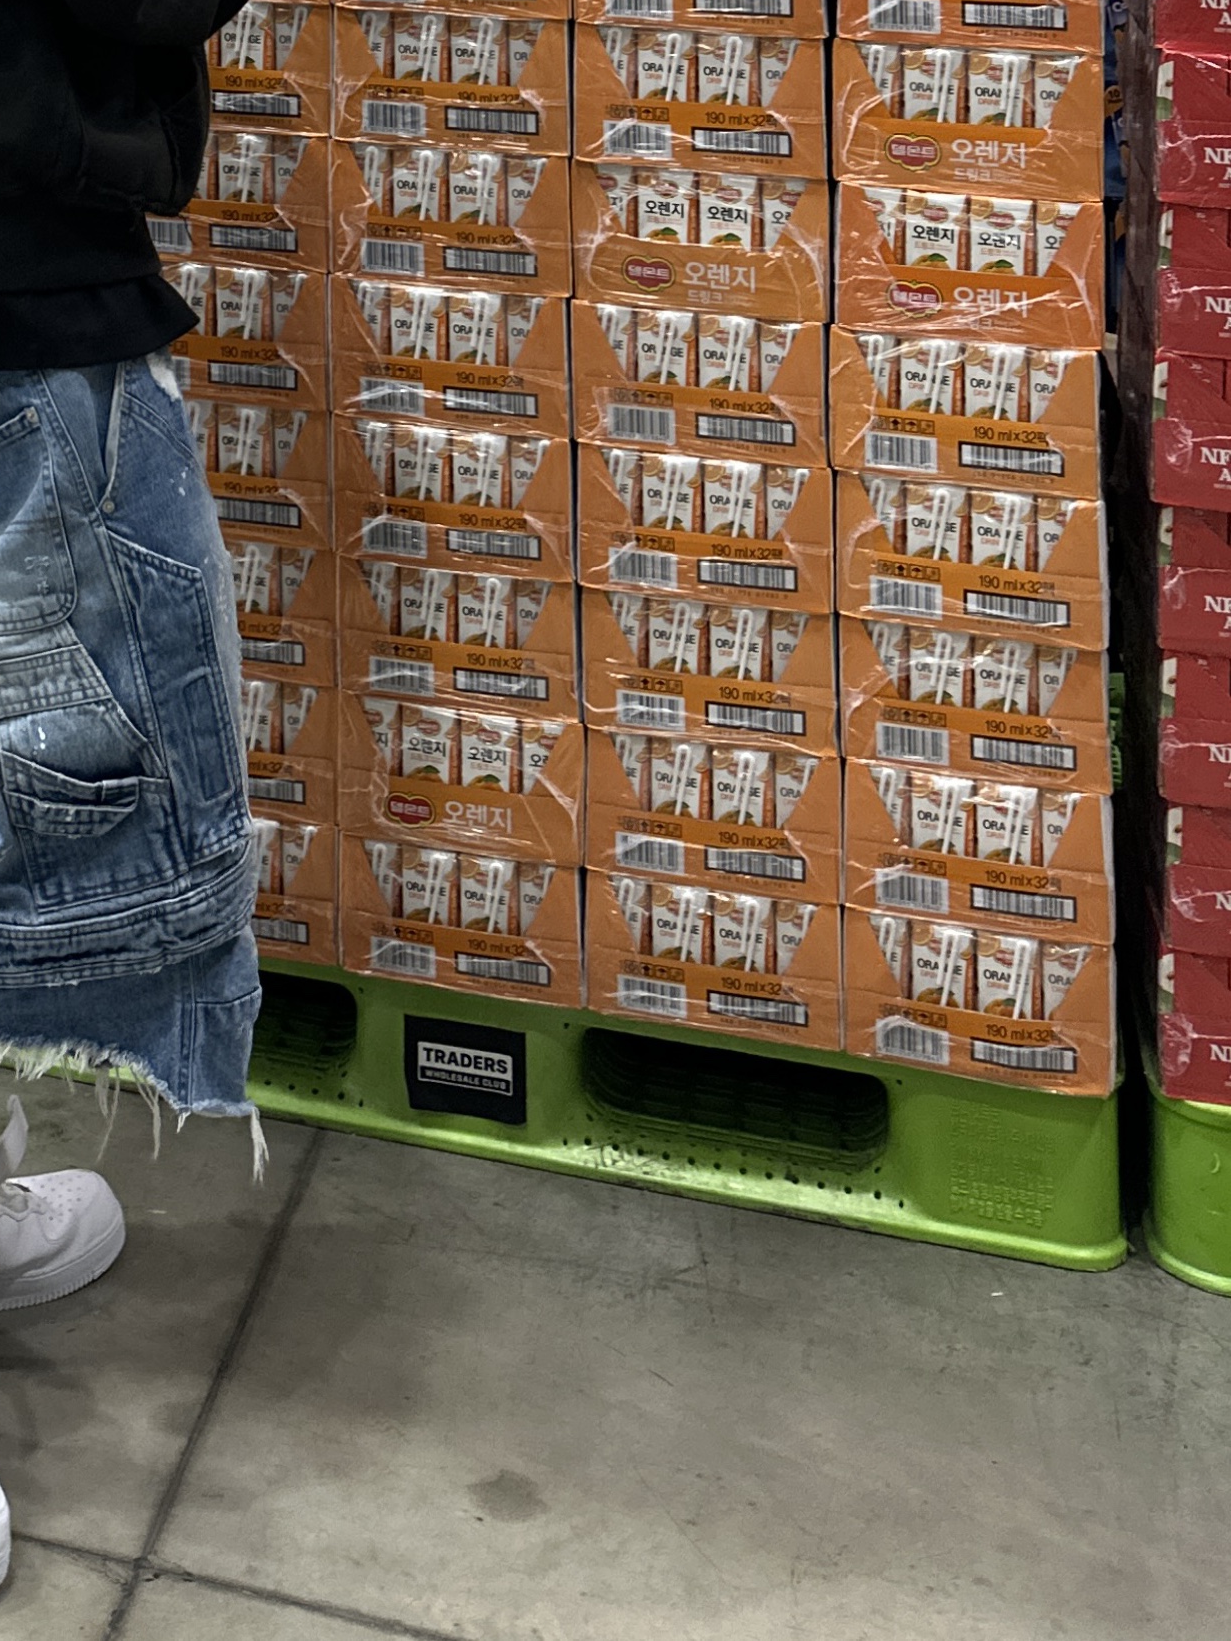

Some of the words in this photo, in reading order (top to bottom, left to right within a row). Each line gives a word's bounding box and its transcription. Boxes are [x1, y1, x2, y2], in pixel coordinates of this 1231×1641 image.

[950, 138, 1026, 168] 오렌지
[645, 201, 684, 218] 오렌지
[683, 262, 756, 293] 오렌지
[953, 287, 1027, 318] 오렌지
[442, 801, 512, 833] 오렌지
[423, 1047, 507, 1074] TRADERS
[424, 1070, 479, 1085] WHOLESALE
[482, 1080, 506, 1089] CLUB
